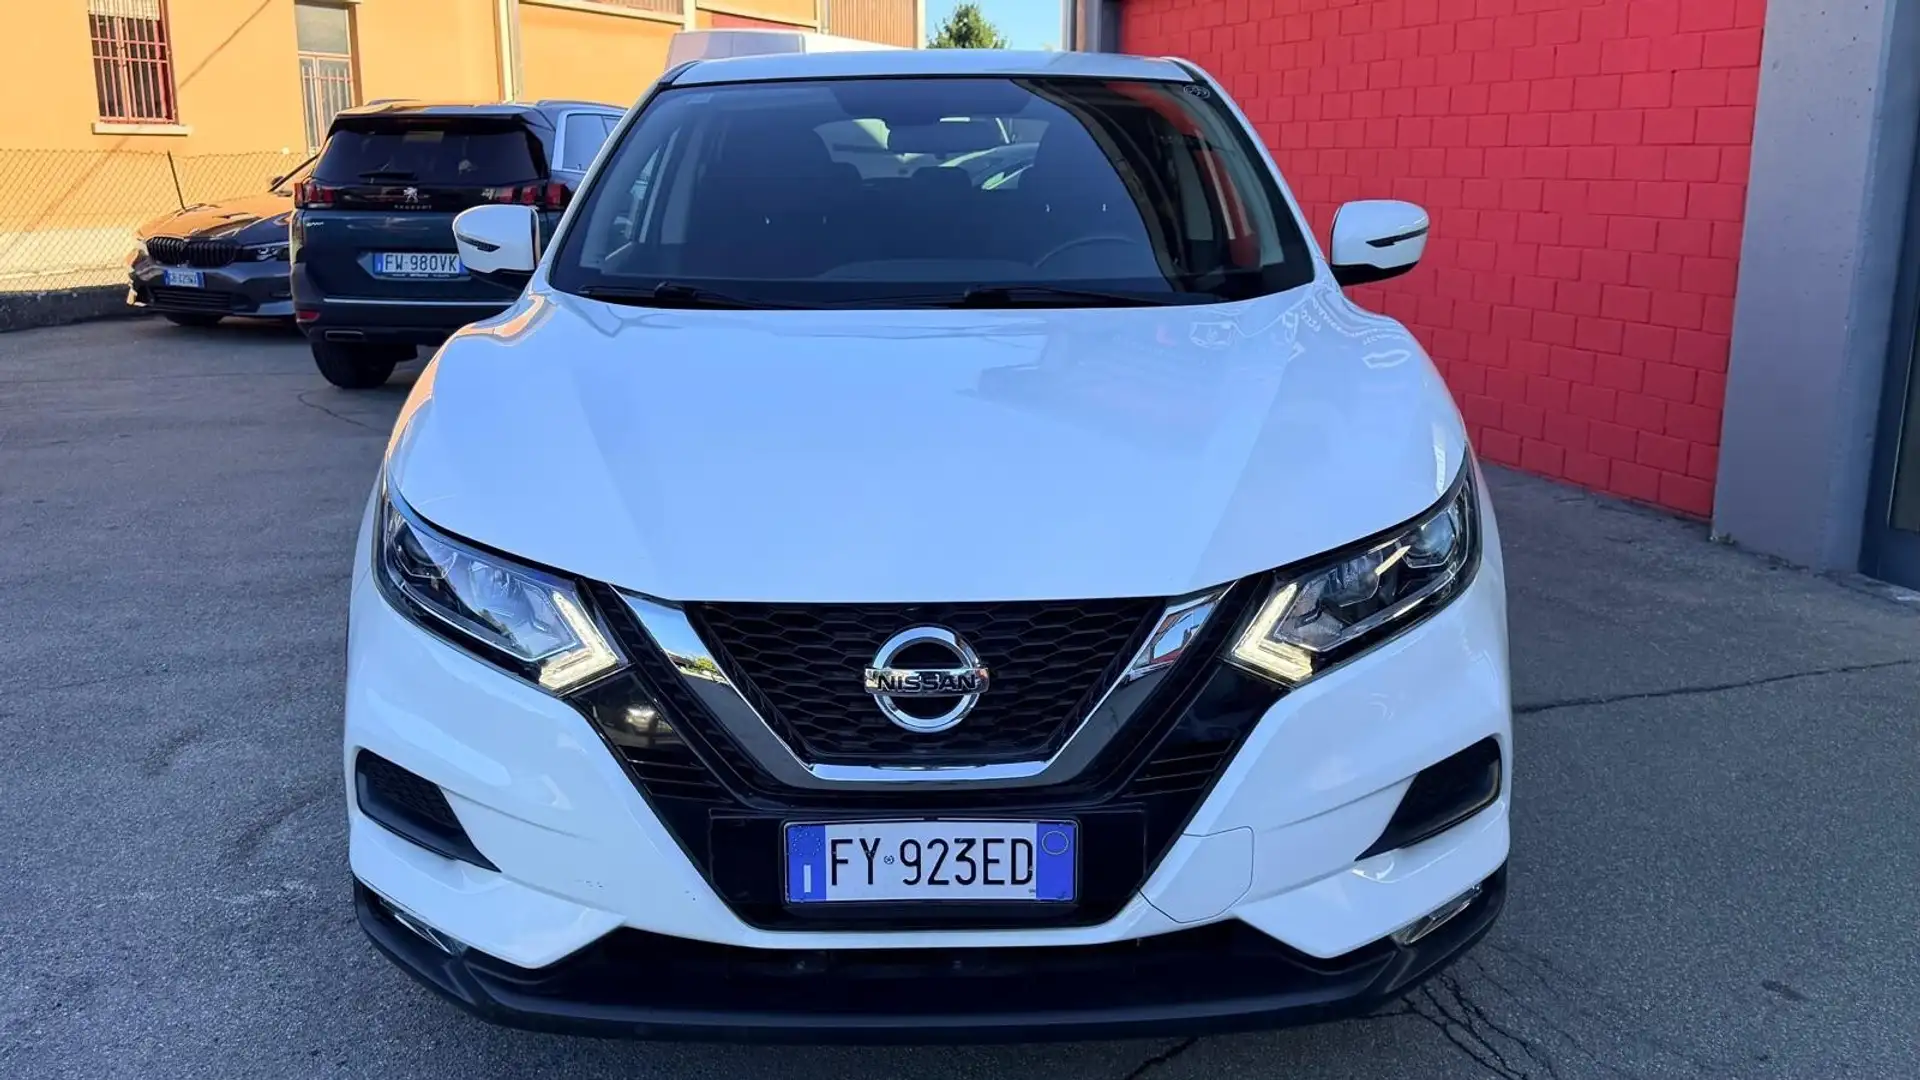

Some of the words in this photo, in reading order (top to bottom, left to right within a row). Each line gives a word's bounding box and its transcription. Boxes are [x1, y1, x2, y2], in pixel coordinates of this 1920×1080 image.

[385, 254, 404, 271] FW
[410, 255, 457, 271] 980VK
[877, 673, 977, 692] NISSAN
[830, 837, 881, 886] FY
[899, 837, 1034, 886] 923ED
